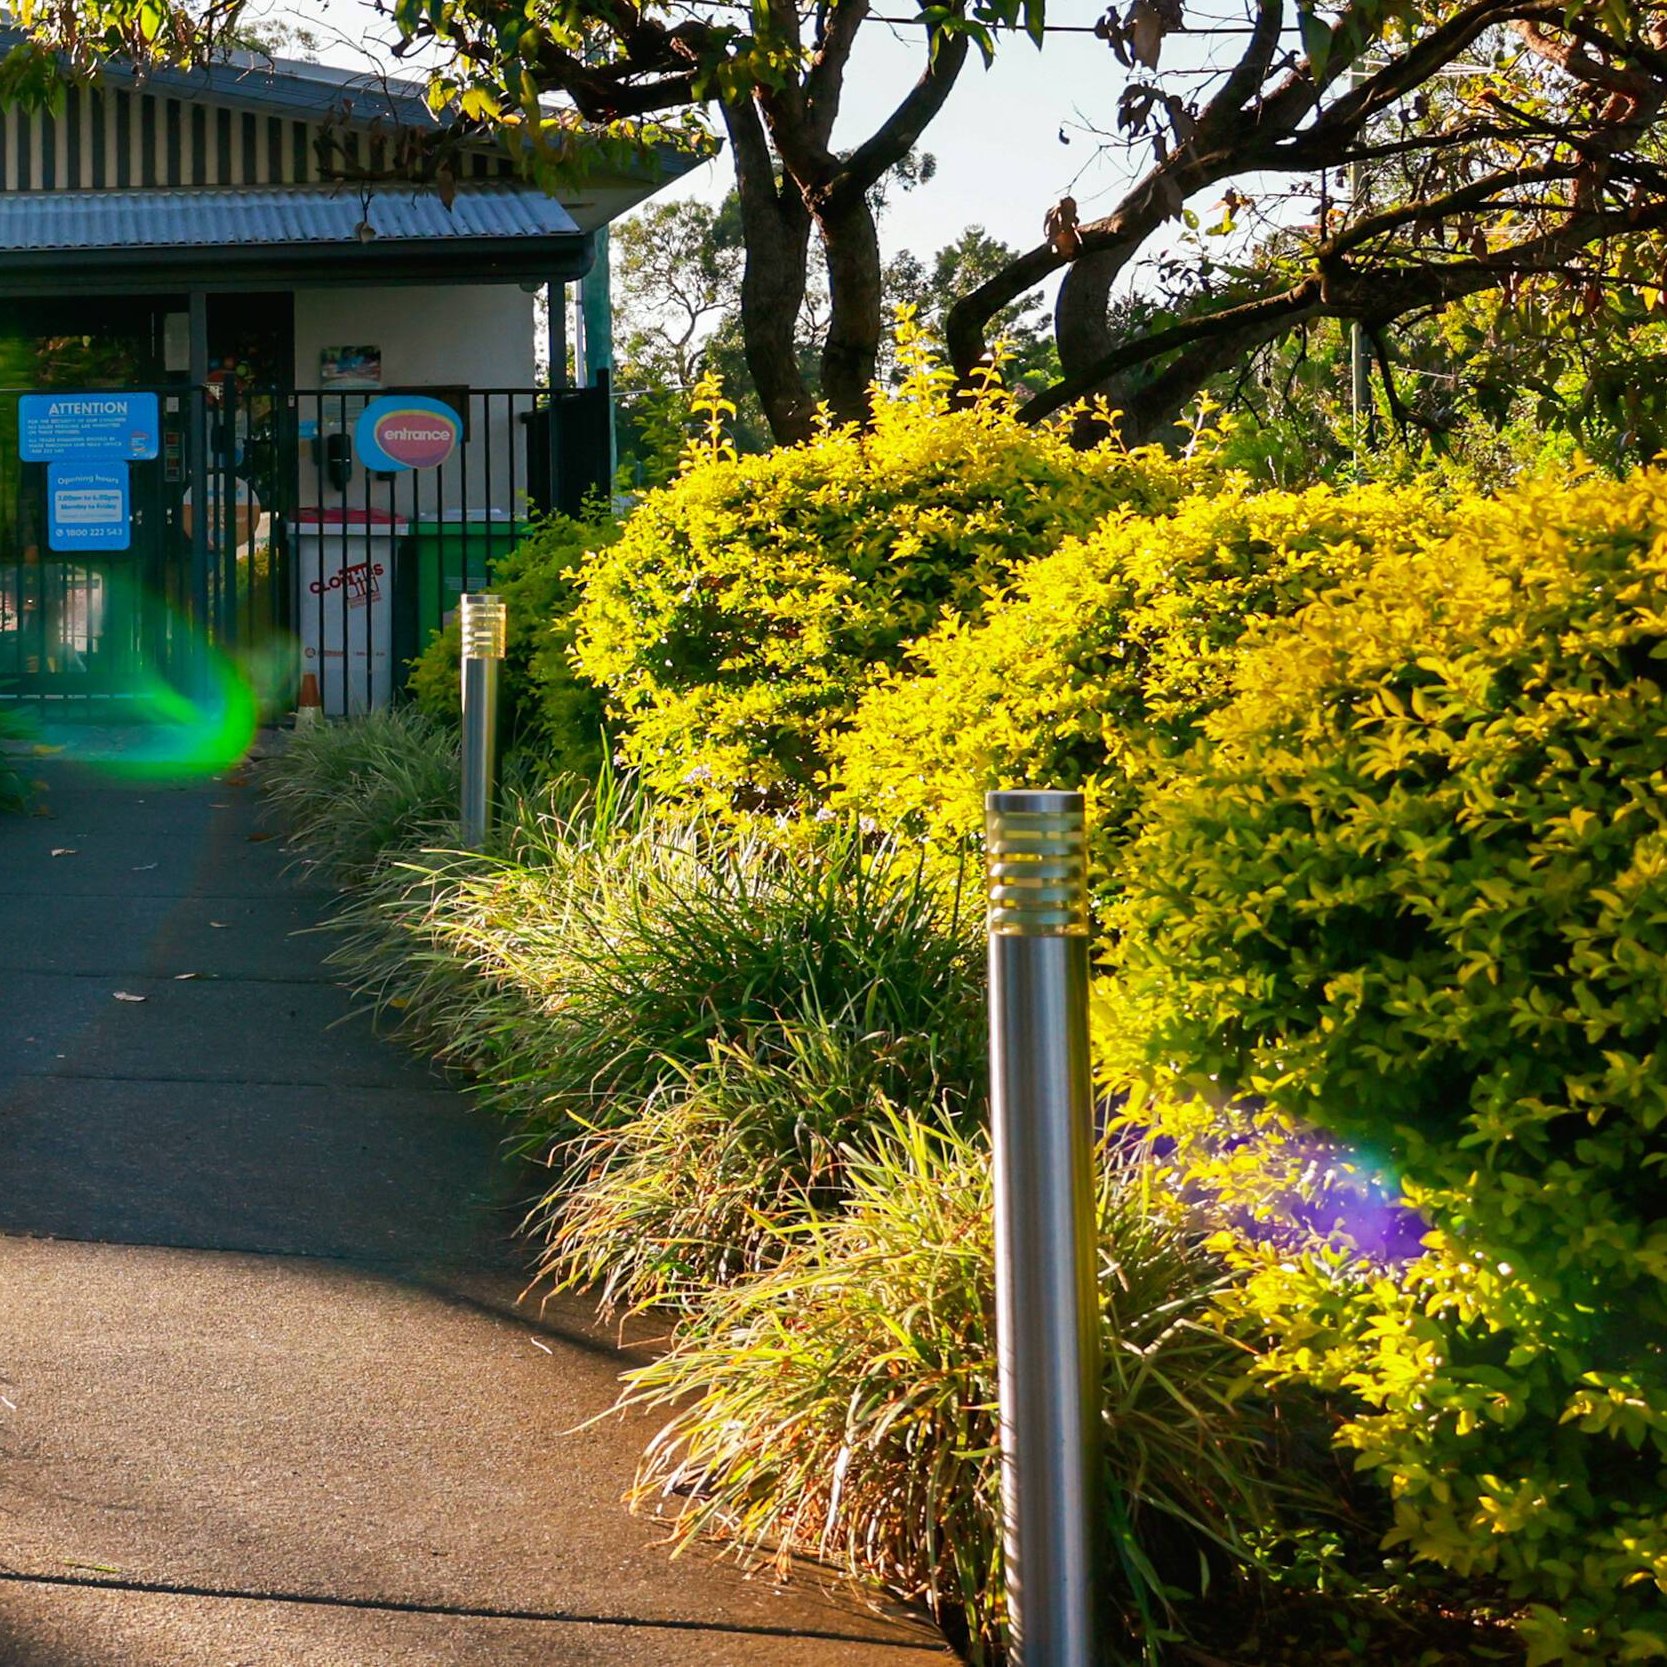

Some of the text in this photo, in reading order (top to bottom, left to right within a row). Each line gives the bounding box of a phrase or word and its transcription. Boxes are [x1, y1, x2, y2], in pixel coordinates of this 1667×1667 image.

[49, 401, 127, 415] ATTENTION
[384, 427, 451, 441] entrance
[58, 473, 119, 485] Opening hours
